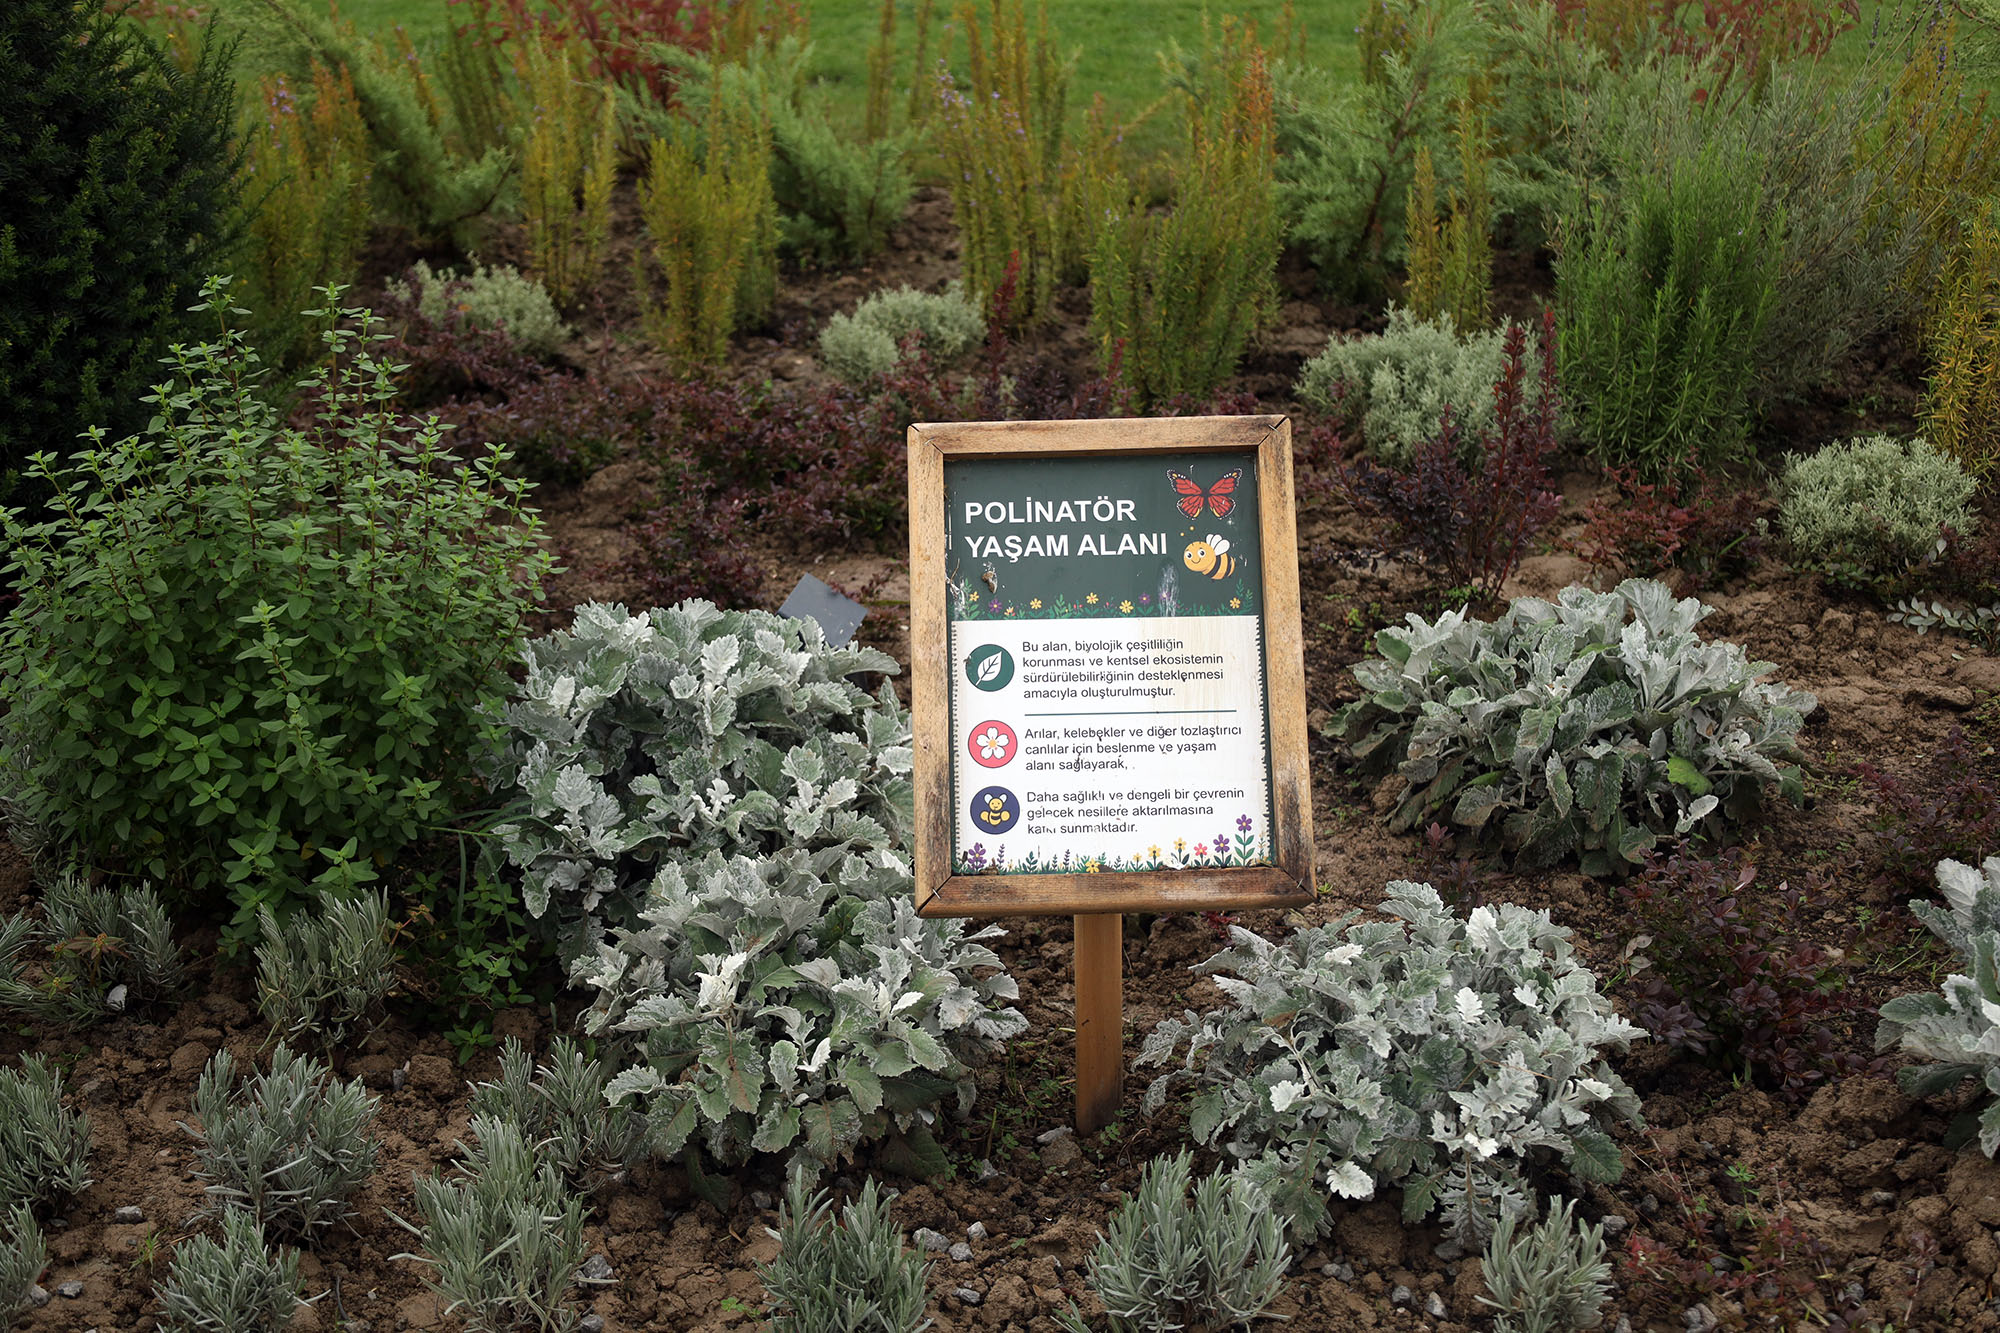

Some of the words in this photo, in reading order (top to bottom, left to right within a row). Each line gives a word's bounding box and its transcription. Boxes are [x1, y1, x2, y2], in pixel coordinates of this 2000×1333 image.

[964, 496, 1137, 524] POLİNATÖR
[964, 535, 1069, 563] YAŞAM
[1077, 533, 1167, 556] ALANI
[1022, 641, 1039, 652] Bu
[1042, 641, 1071, 653] alan,
[1075, 640, 1123, 653] biyolojik
[1126, 639, 1184, 652] çeşitliliğin
[1022, 657, 1085, 667] korunması
[1089, 658, 1103, 666] ve
[1106, 655, 1149, 666] kentsel
[1152, 654, 1224, 665] ekosistemin
[1138, 669, 1224, 683] desteklenmesi
[1023, 688, 1078, 700] amacıyla
[1081, 686, 1176, 699] oluşturulmuştur.
[1024, 728, 1060, 740] Arılar,
[1064, 727, 1126, 739] kelebekler
[1129, 728, 1143, 737] ve
[1147, 726, 1177, 739] diğer
[1180, 725, 1242, 738] tozlaştırıcı
[1025, 744, 1069, 754] canlılar
[1072, 743, 1093, 756] için
[1096, 742, 1155, 753] beslenme
[1158, 744, 1173, 752] ve
[1176, 743, 1217, 754] yaşam
[1025, 760, 1055, 770] alanı
[1058, 757, 1128, 773] sağlayarak,
[1027, 791, 1059, 802] Daha
[1062, 790, 1105, 804] sağlıklı
[1108, 792, 1124, 800] ve
[1127, 789, 1171, 802] dengeli
[1174, 788, 1190, 799] bir
[1193, 787, 1245, 801] çevrenin
[1078, 806, 1129, 817] nesillere
[1132, 804, 1214, 816] aktarılmasına
